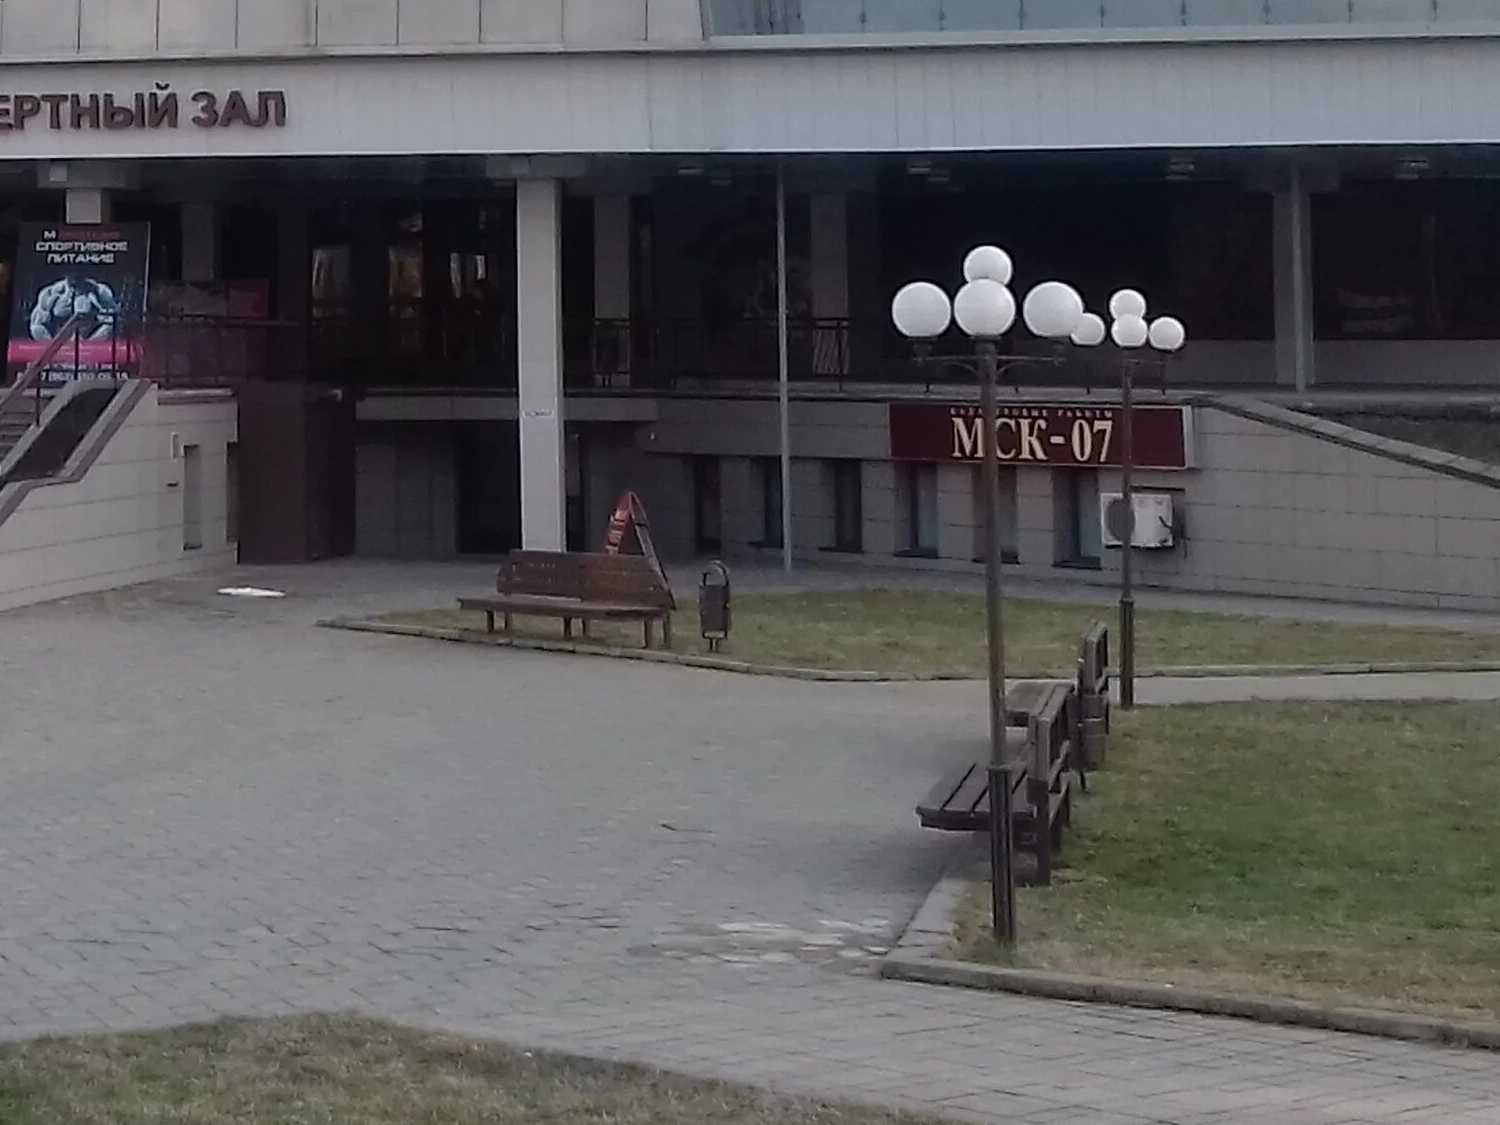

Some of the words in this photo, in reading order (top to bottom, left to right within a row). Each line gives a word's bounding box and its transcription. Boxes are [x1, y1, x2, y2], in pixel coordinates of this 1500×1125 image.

[191, 90, 288, 128] ЗАЛ
[35, 241, 127, 252] СПОРТИВНОЕ
[47, 254, 115, 264] ПИТАНИЕ
[951, 418, 1114, 463] МСК-07
